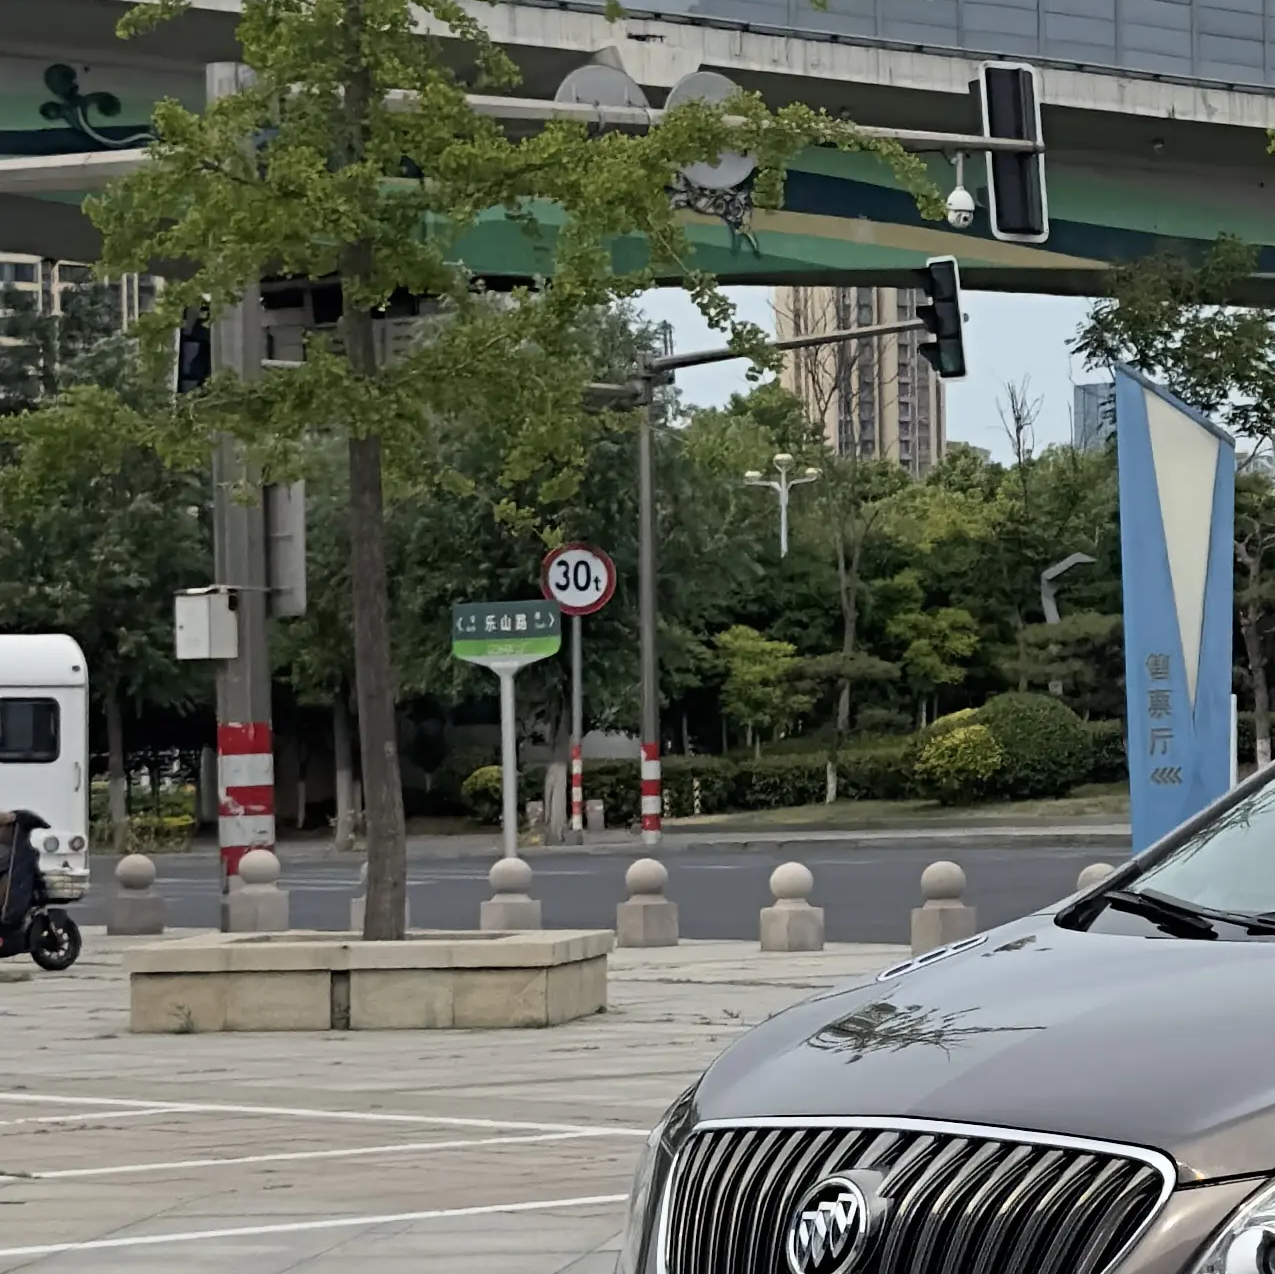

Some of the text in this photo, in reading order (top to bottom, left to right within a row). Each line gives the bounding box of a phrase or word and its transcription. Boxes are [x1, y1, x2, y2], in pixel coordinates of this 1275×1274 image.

[554, 559, 602, 592] 30t
[484, 613, 528, 632] 乐山路
[1145, 653, 1175, 756] 售票厅
